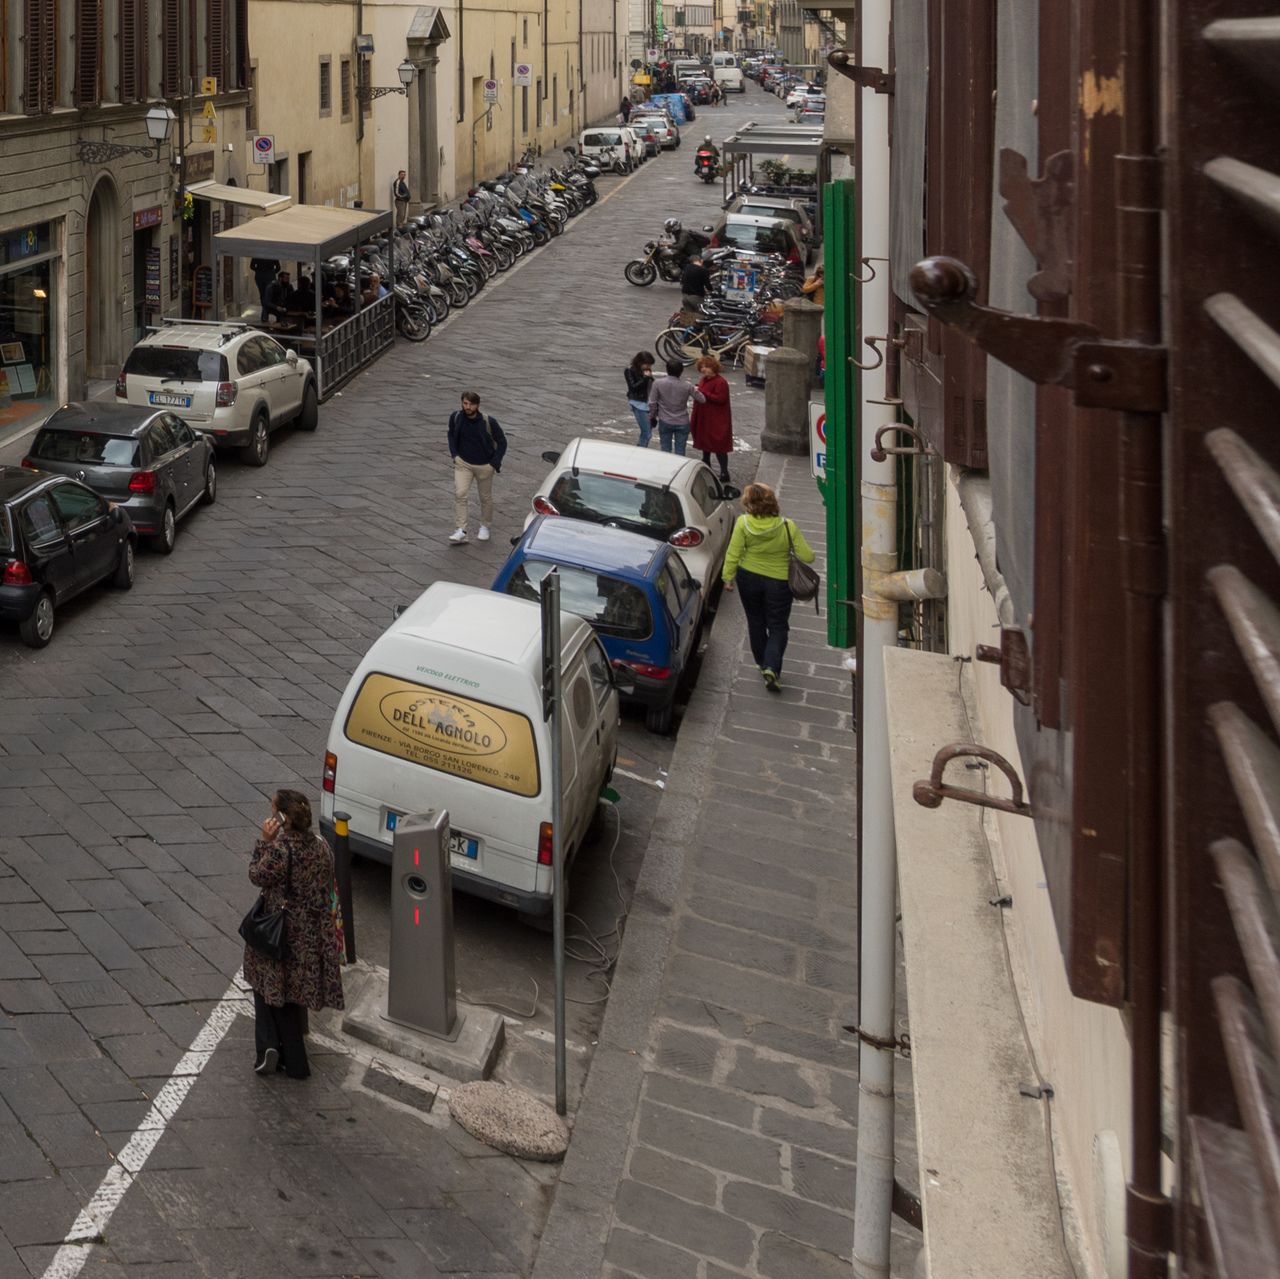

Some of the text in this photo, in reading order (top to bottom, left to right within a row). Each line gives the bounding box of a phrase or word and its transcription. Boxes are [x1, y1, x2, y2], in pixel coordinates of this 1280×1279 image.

[416, 665, 480, 688] VEICOLO ELETTRICO
[408, 697, 475, 728] OSTERIA
[435, 721, 491, 748] AGNOLO
[361, 728, 392, 743] FIRENZE
[399, 741, 411, 749] VIA
[413, 745, 441, 758] BORGO
[442, 754, 459, 764] SAN
[504, 772, 521, 782] 24R
